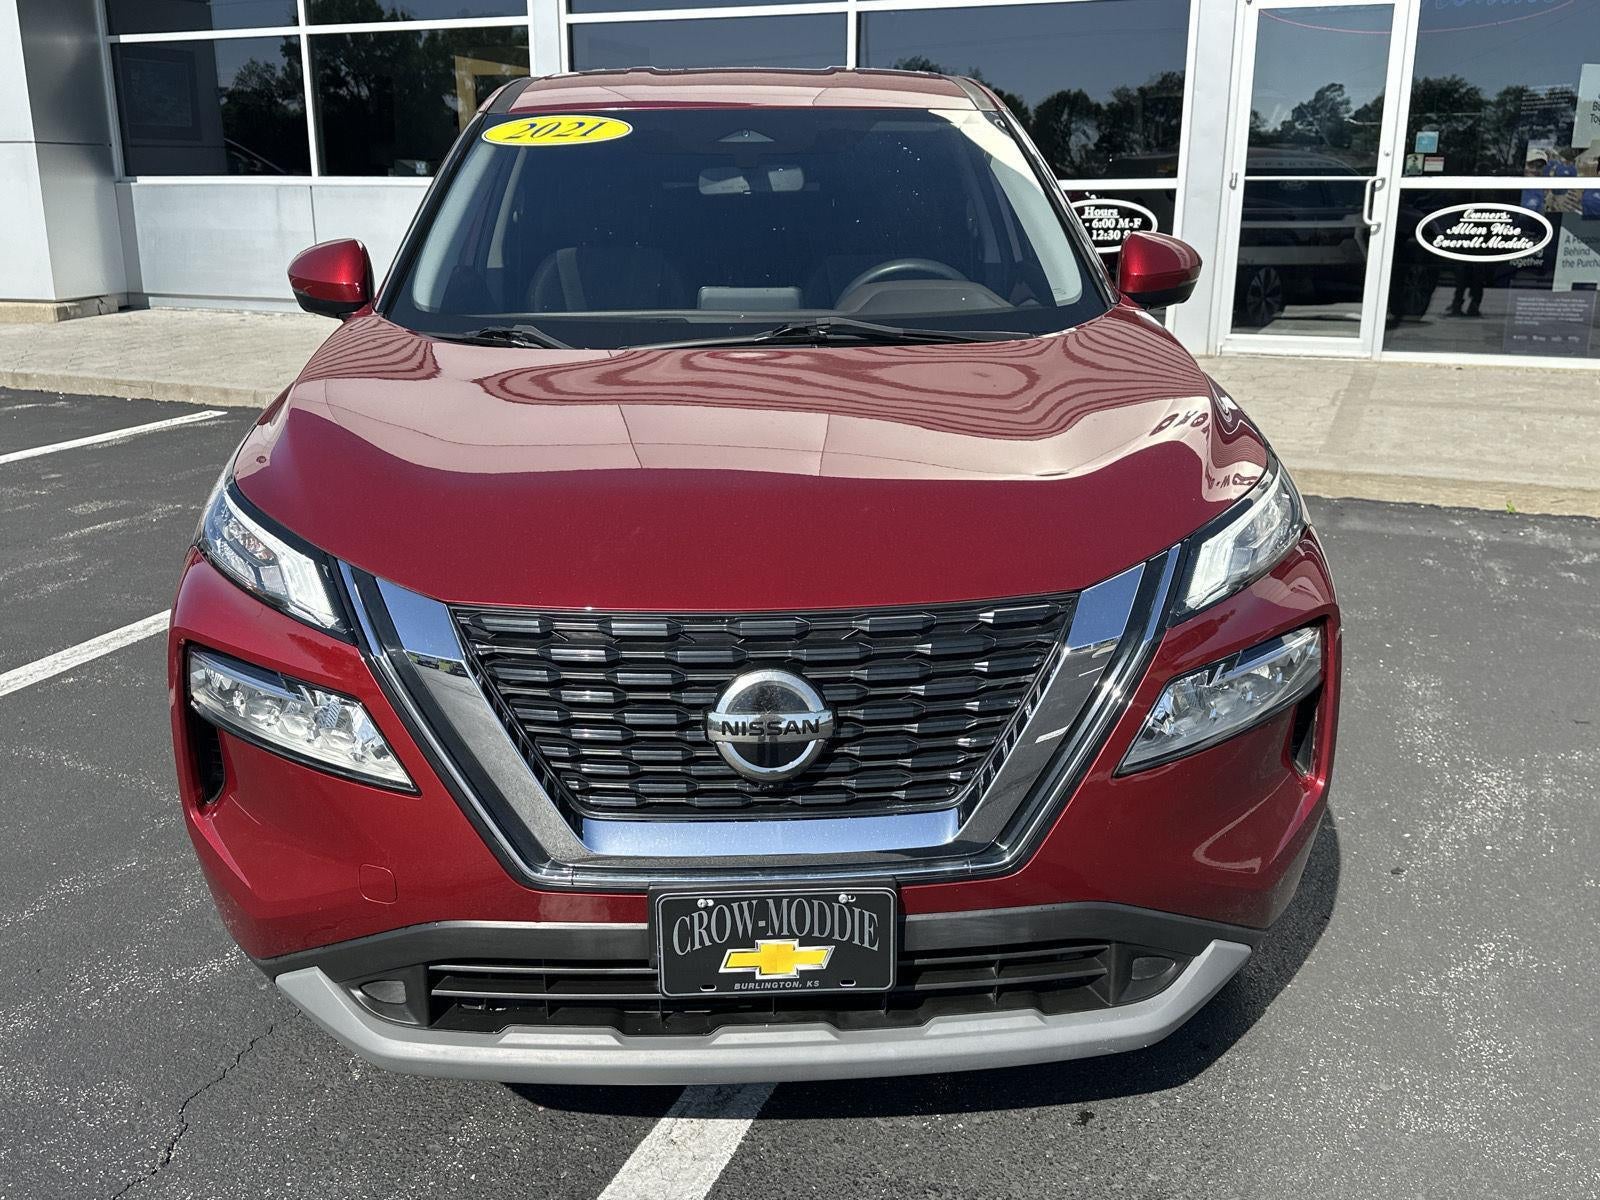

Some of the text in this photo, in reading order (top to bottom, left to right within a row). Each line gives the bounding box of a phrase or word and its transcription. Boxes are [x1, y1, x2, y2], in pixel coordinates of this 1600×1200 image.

[504, 121, 607, 140] 2021
[1083, 206, 1118, 217] Hours
[1091, 218, 1116, 229] 6:00
[1446, 222, 1521, 235] Allen Wise
[1091, 230, 1121, 240] 12:30
[1563, 246, 1590, 256] Behind
[1562, 258, 1575, 268] the
[721, 718, 820, 736] NISSAN
[672, 898, 879, 956] CROW-MODDIE
[733, 980, 820, 990] BURLINGTON, KS
